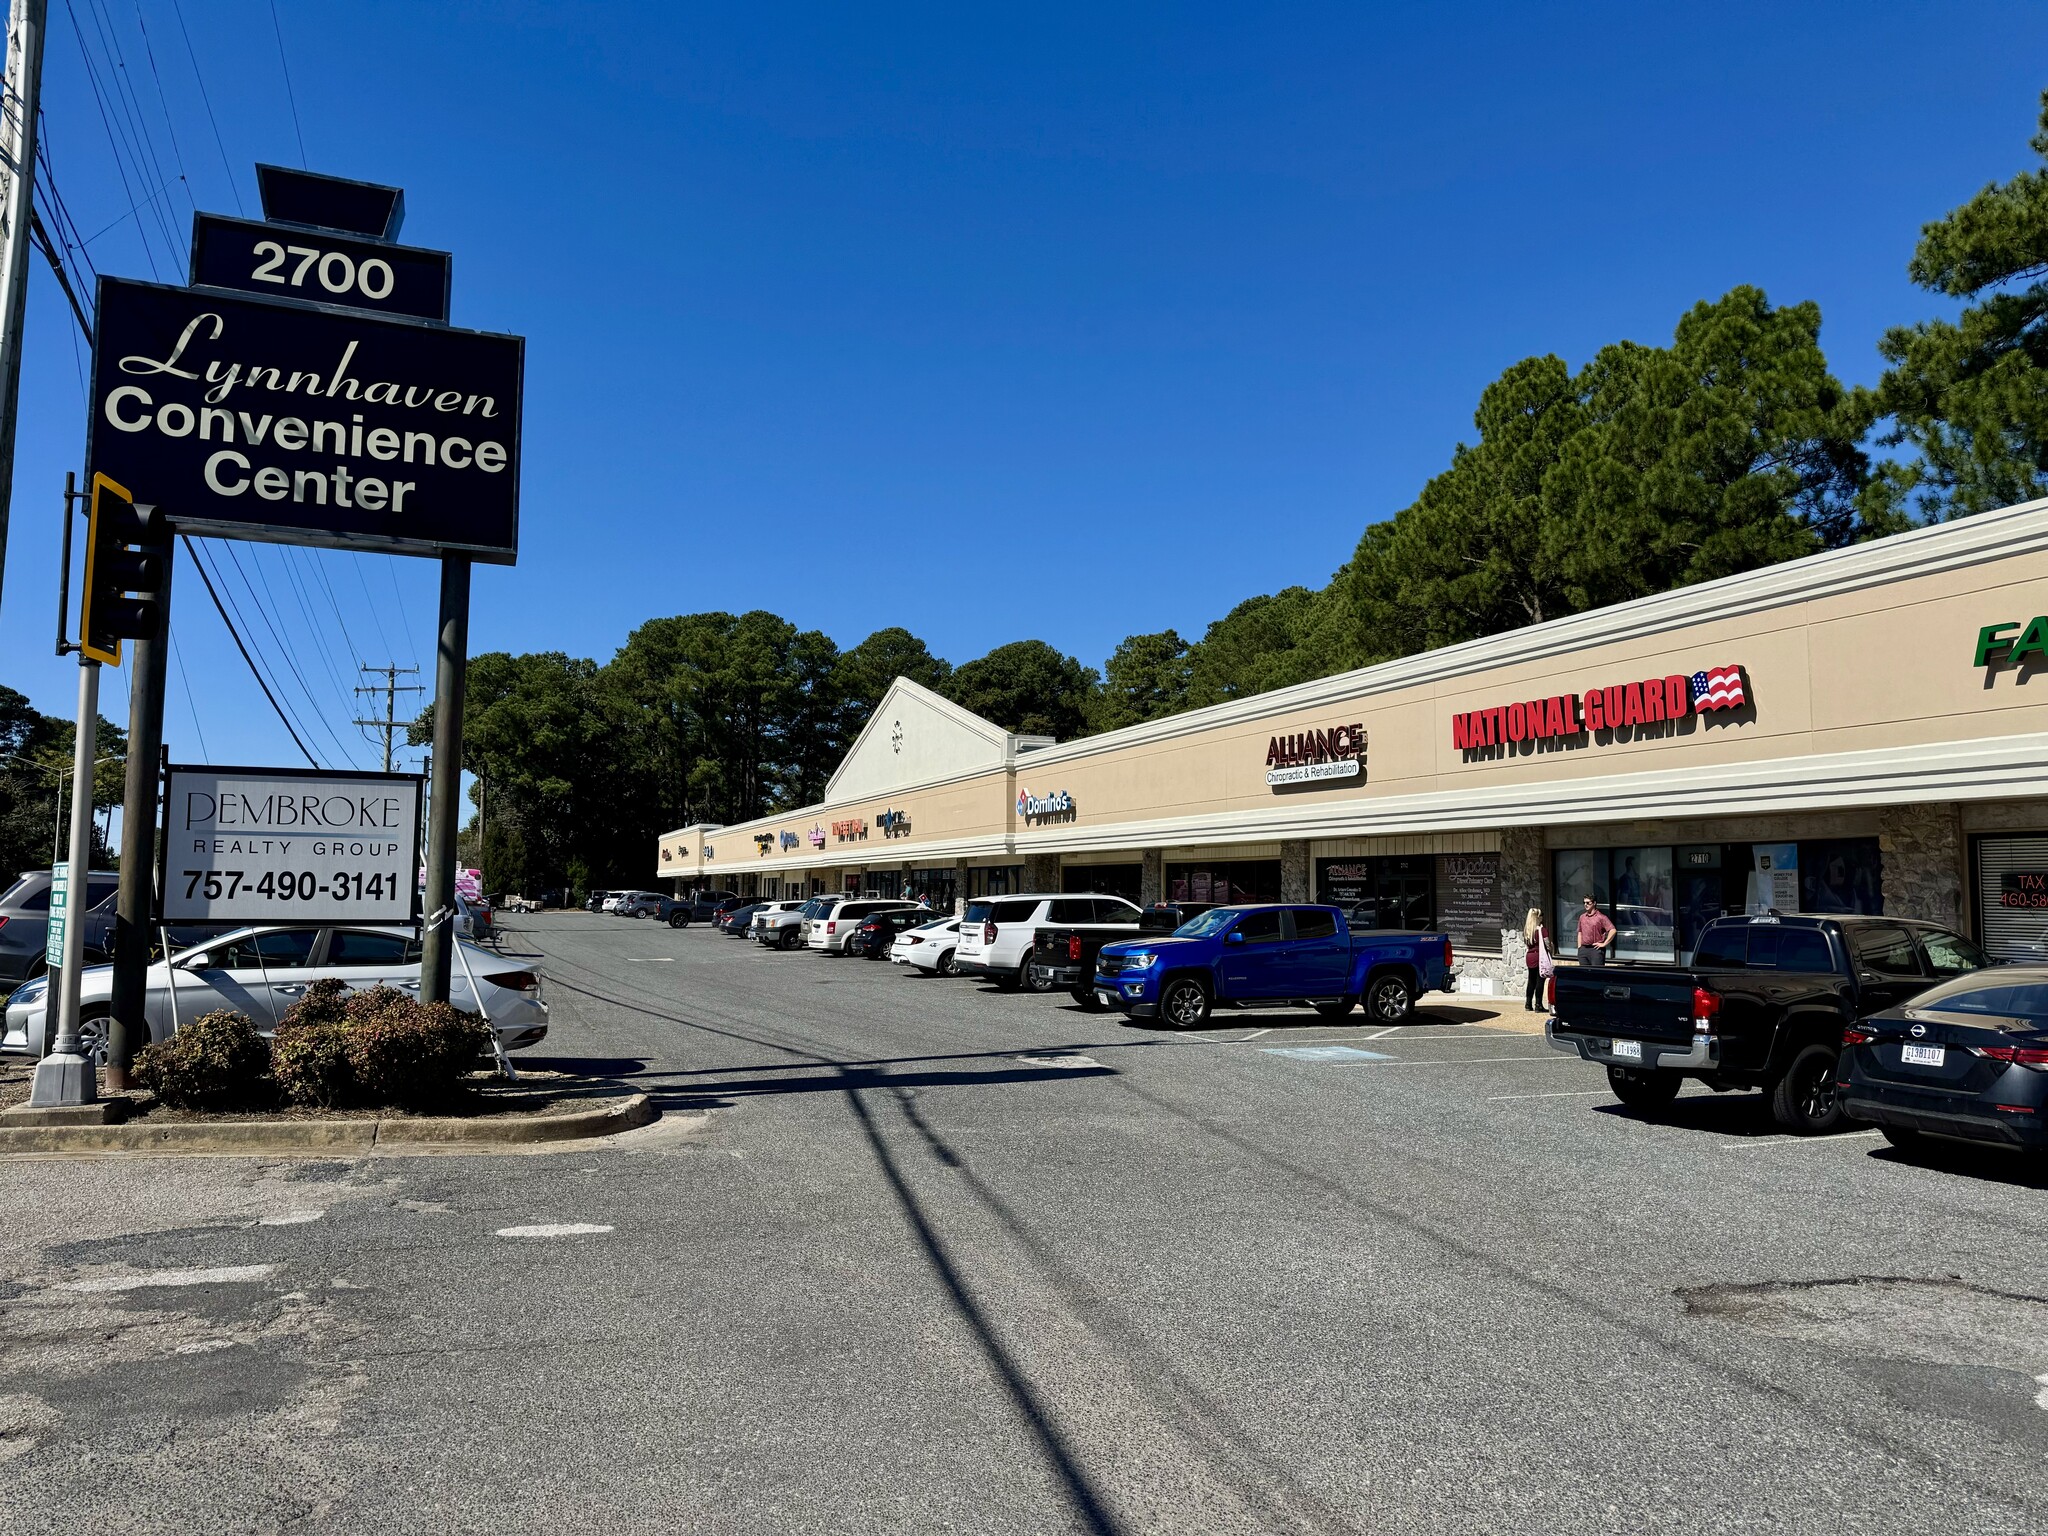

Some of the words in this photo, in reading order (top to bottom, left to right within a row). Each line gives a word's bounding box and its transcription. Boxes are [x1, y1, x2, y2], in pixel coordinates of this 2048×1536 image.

[251, 241, 394, 300] 2700
[118, 313, 499, 418] Lynnhaven
[105, 385, 508, 473] Convenience
[204, 450, 416, 512] Center
[1973, 615, 2048, 667] FA
[1453, 694, 1579, 750] NATIONAL
[1584, 675, 1687, 732] GUARD
[1266, 723, 1362, 766] ALLIANCE
[1267, 769, 1303, 783] Chiropractic
[1304, 767, 1310, 778] &
[1311, 763, 1357, 778] Rehabilitation
[186, 792, 400, 830] PEMBROKE
[1027, 790, 1068, 815] Domino's
[193, 839, 291, 854] REALTY
[313, 841, 398, 857] GROUP
[183, 870, 397, 901] 757-490-3141
[2000, 892, 2048, 907] 460-58
[2018, 874, 2046, 890] TAX
[1558, 935, 1578, 943] CITIZE
